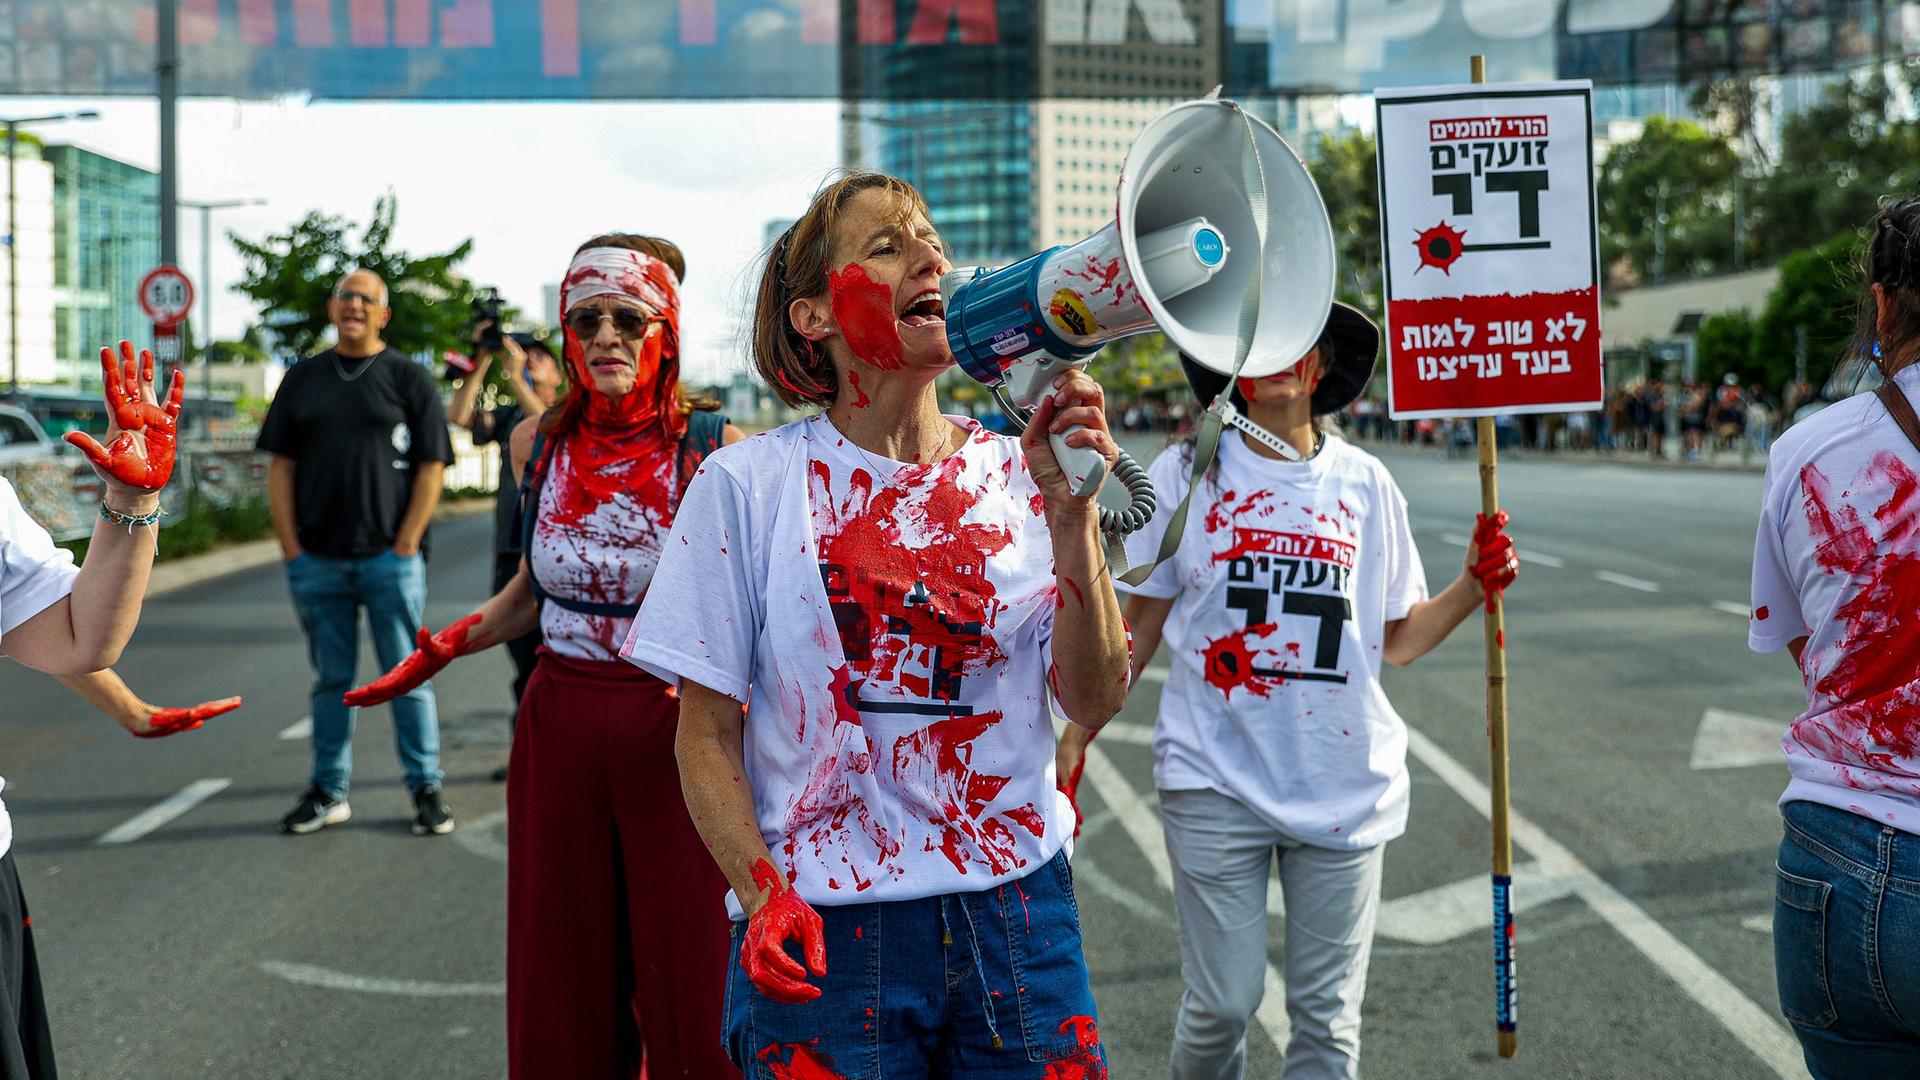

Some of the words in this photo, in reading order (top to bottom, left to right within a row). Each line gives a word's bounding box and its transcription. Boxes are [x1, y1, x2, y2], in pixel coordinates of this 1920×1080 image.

[1431, 117, 1502, 140] לוחמים
[1506, 118, 1547, 136] הורי
[1429, 140, 1549, 177] זועקים
[1431, 169, 1549, 238] די
[1401, 316, 1476, 351] למות
[1487, 319, 1533, 346] טוב
[1544, 311, 1587, 343] לא
[1416, 352, 1503, 381] עריצנו
[1511, 349, 1572, 376] בעד
[1225, 585, 1353, 671] די
